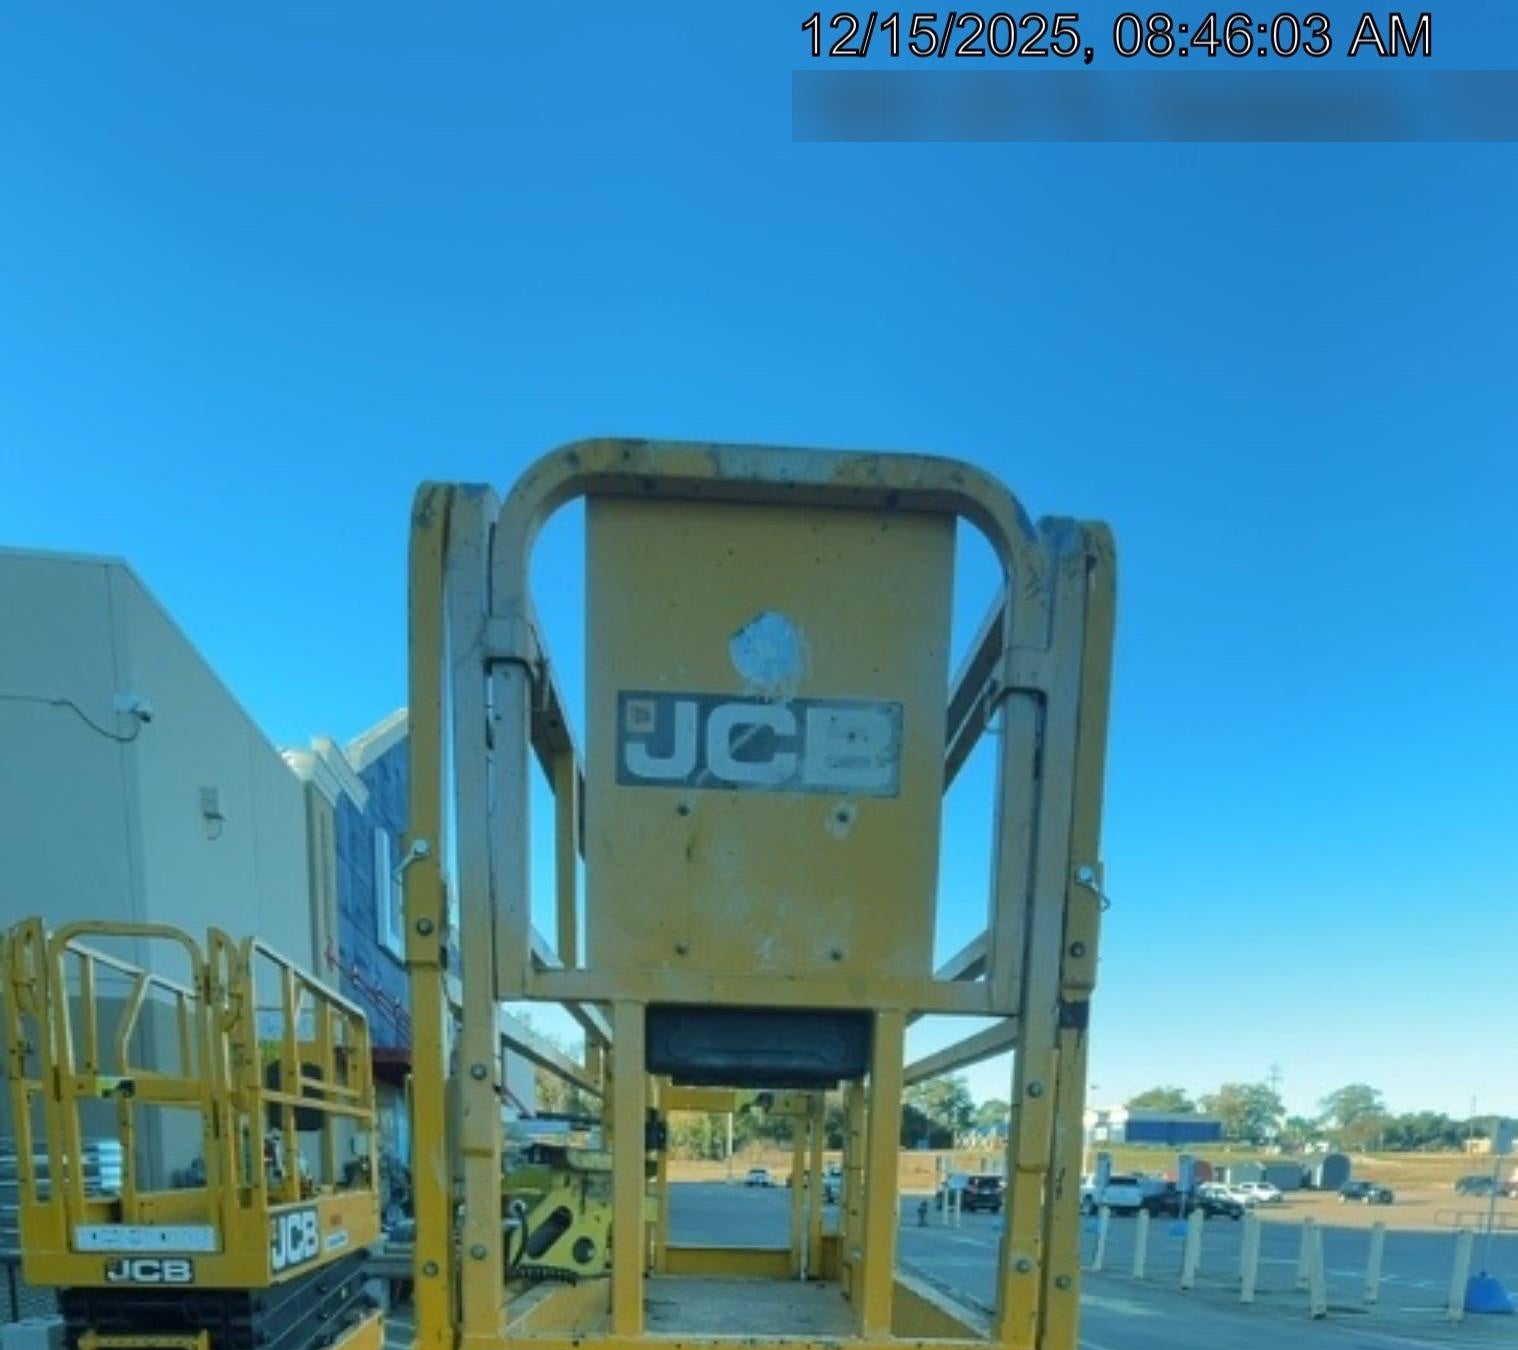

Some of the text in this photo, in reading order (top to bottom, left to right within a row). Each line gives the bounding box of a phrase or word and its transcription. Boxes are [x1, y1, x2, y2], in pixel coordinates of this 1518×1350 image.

[624, 700, 893, 785] JCB
[271, 1208, 317, 1270] JCB
[107, 1259, 192, 1282] JCB
